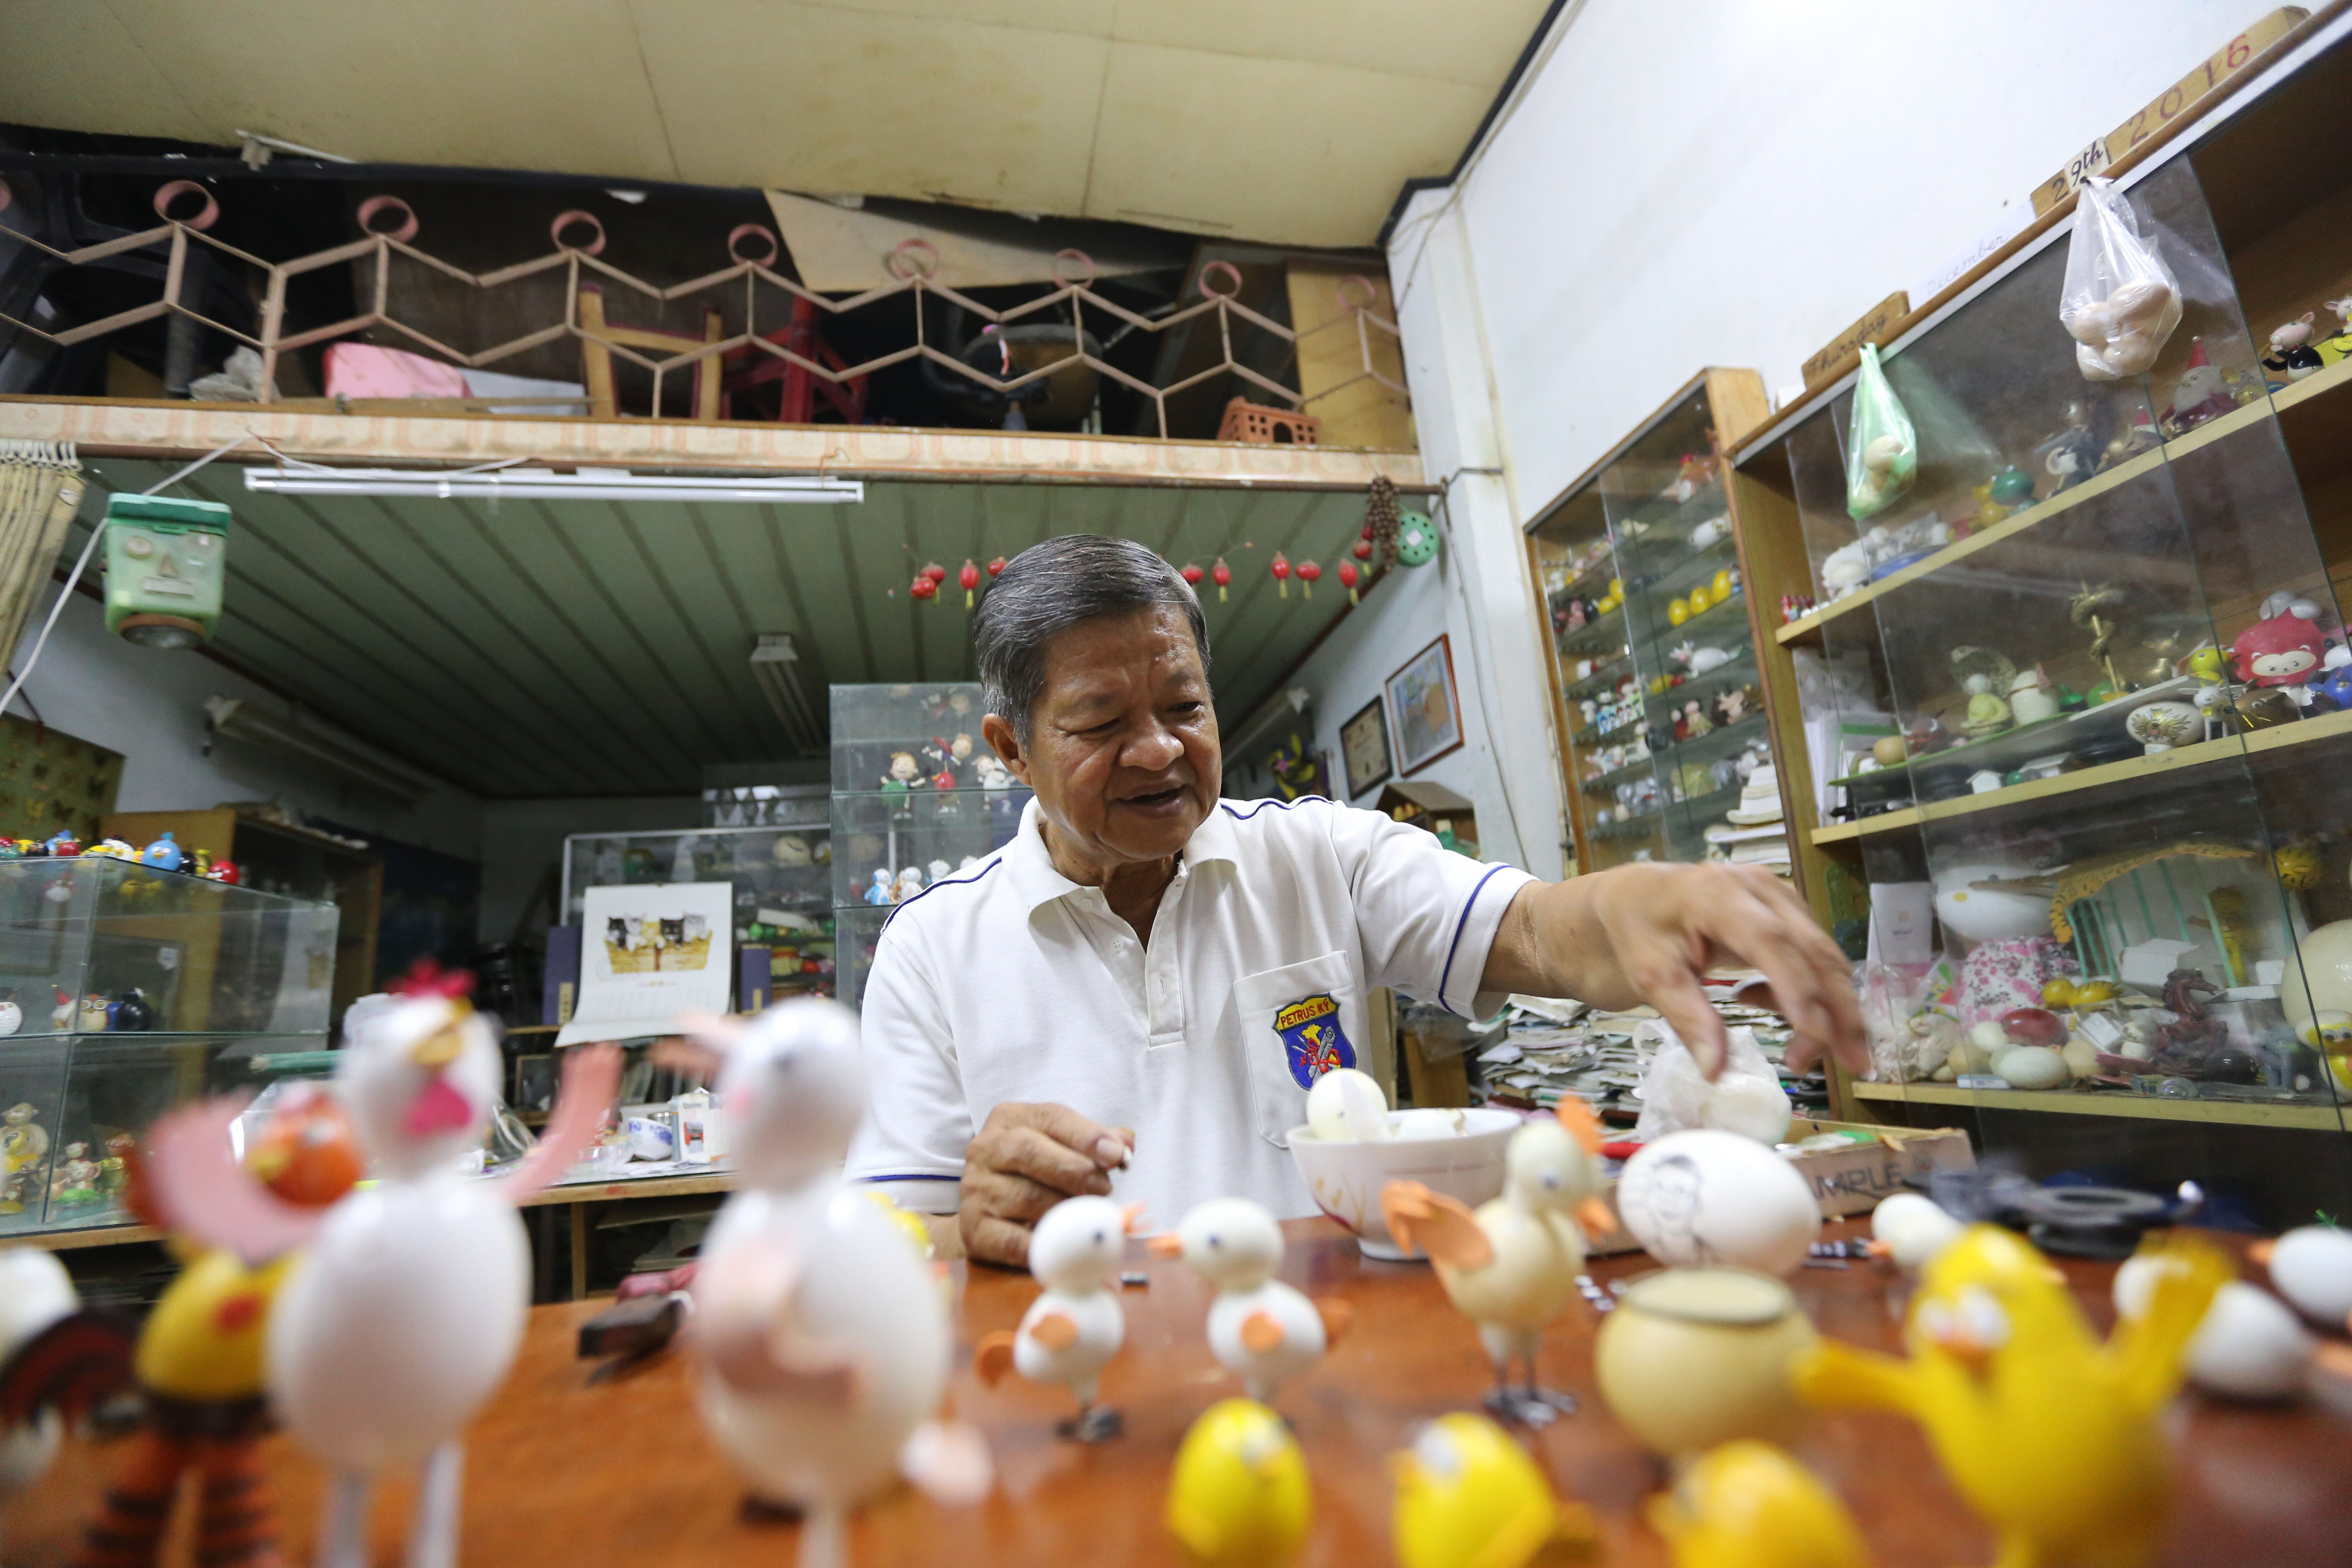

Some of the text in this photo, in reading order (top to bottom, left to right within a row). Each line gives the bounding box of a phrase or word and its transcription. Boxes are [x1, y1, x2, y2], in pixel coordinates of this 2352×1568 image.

[2052, 140, 2103, 202] 29th
[2128, 34, 2250, 147] 2016
[1280, 998, 1329, 1029] PETRUS KÝ
